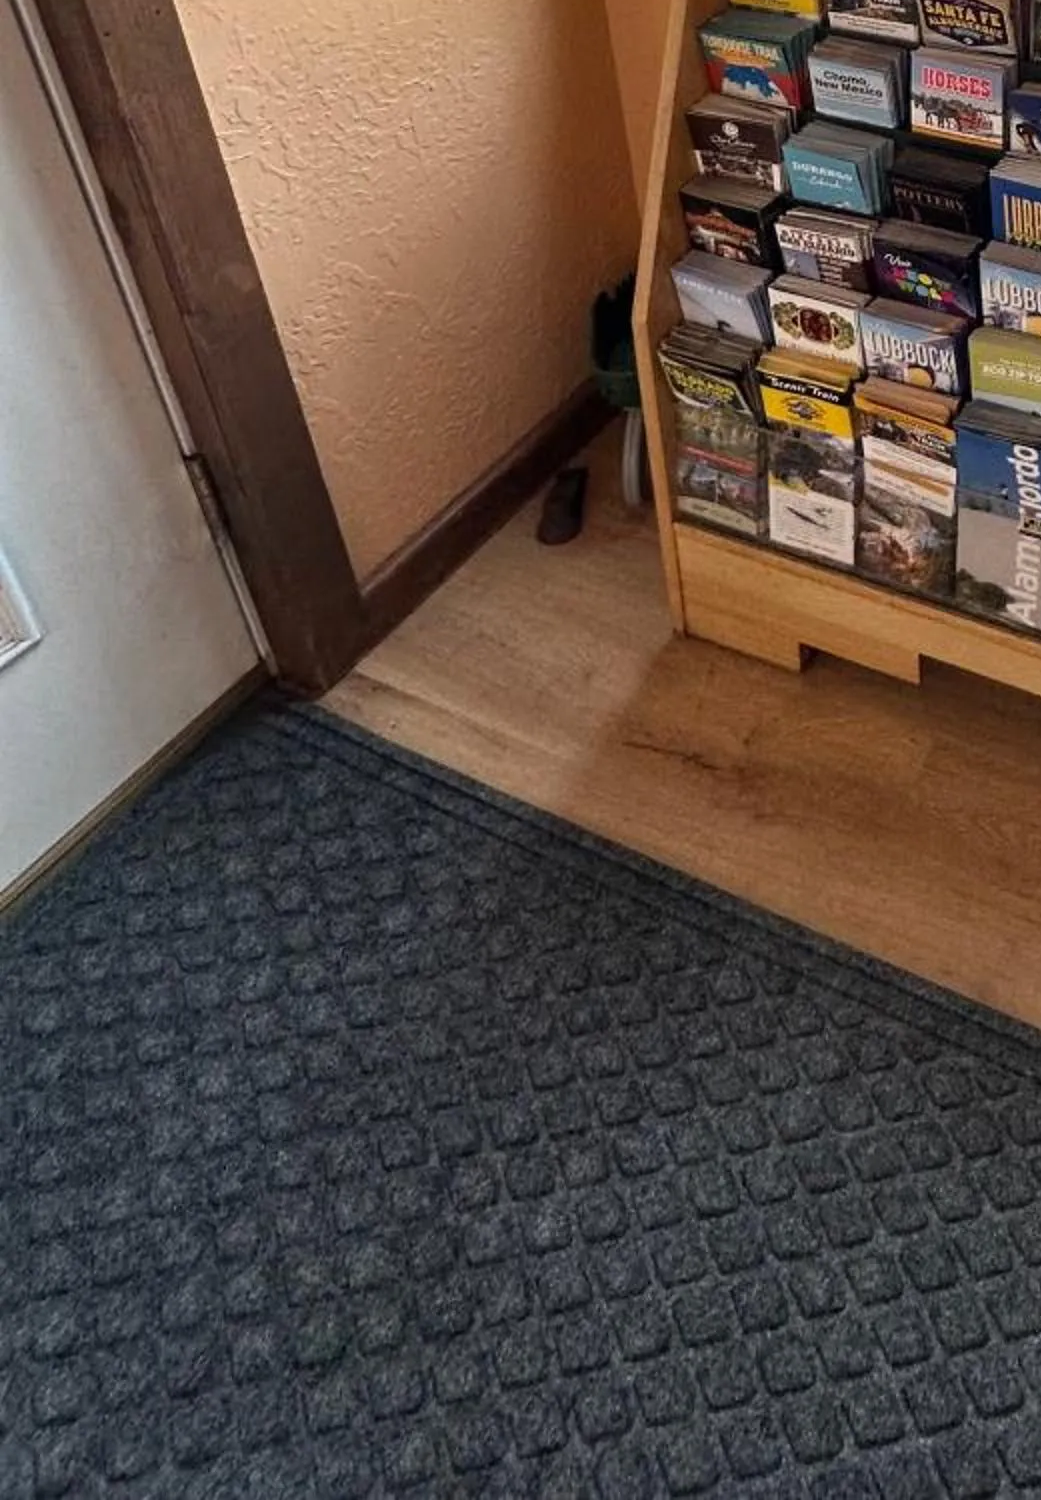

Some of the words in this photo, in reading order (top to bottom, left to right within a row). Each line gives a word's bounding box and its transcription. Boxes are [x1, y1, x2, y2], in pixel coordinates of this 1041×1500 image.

[923, 0, 978, 23] SANTA
[979, 11, 1002, 28] FE
[814, 77, 839, 90] New
[841, 82, 883, 98] Mexico
[921, 67, 993, 99] HORSES
[864, 329, 957, 376] LUBBOCK
[770, 377, 807, 394] Scenic
[810, 385, 841, 404] Train
